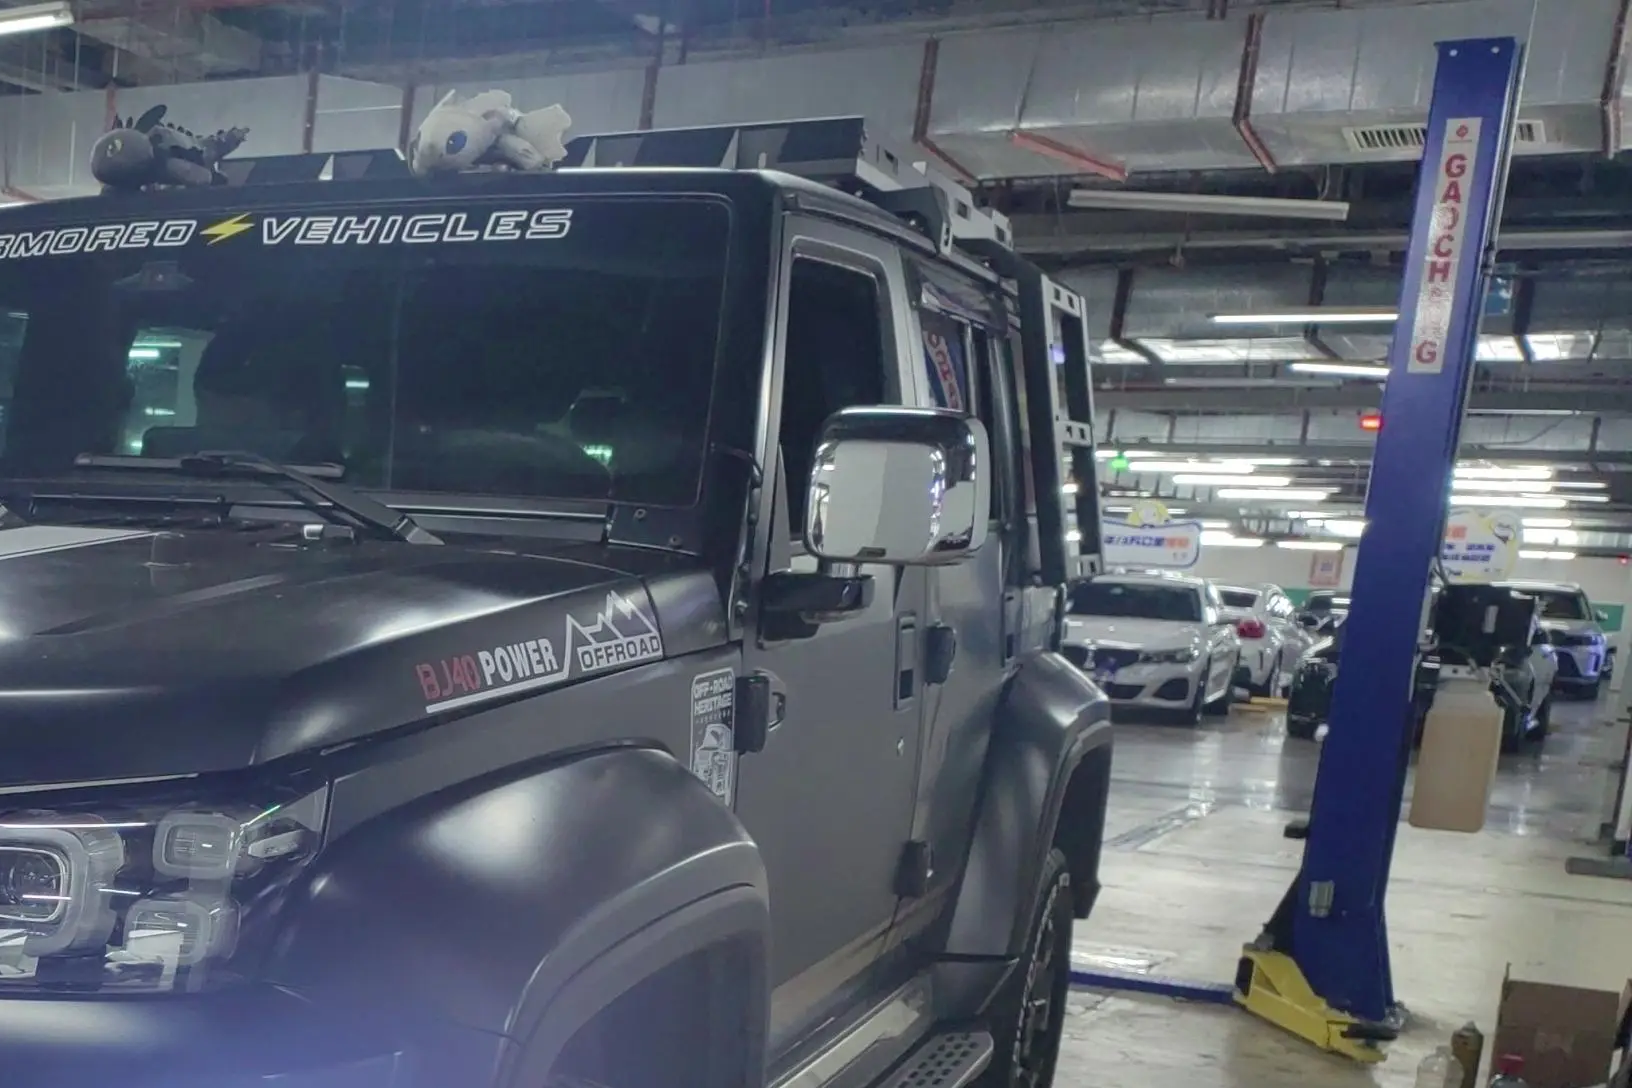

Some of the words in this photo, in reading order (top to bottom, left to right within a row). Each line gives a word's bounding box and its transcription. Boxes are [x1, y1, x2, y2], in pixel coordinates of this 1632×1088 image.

[262, 209, 574, 246] VEHICLES
[415, 655, 481, 700] BJ40
[478, 638, 559, 686] POWER
[580, 635, 661, 669] OFFROAD
